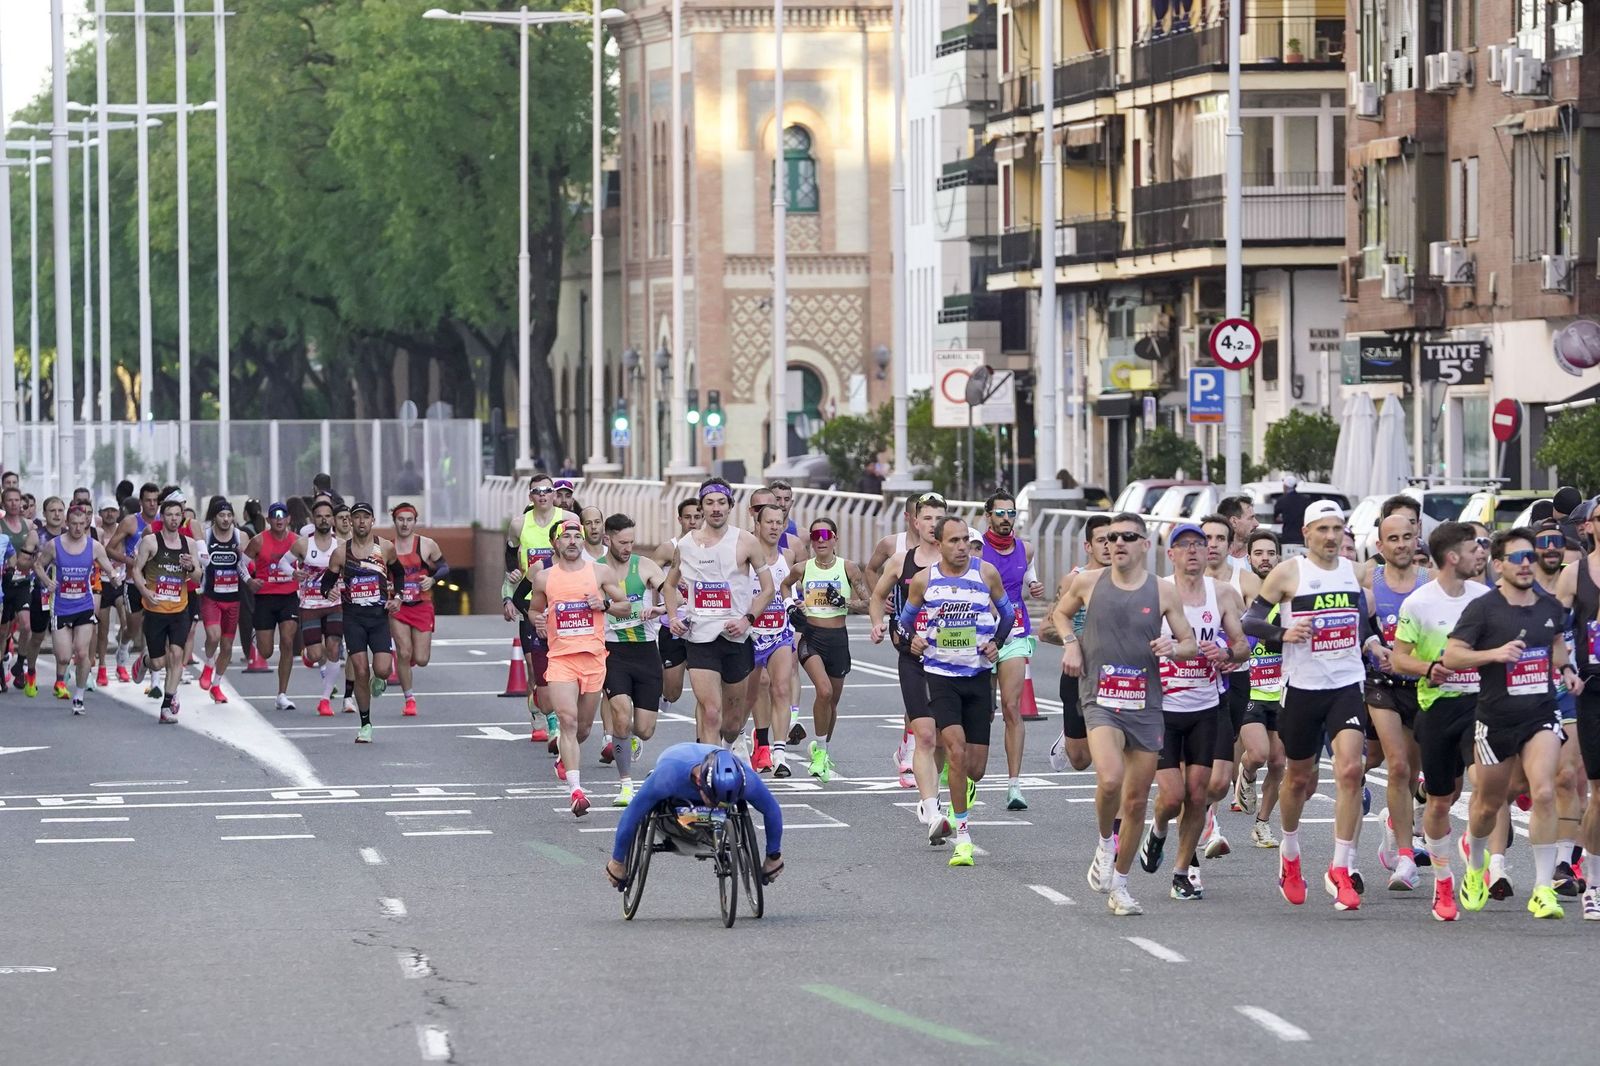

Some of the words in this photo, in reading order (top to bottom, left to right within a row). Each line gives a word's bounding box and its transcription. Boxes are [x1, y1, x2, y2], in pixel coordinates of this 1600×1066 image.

[1424, 344, 1480, 359] TINTE
[1194, 373, 1216, 402] P
[702, 599, 724, 608] ROBIN
[941, 602, 972, 613] CORRE
[1313, 593, 1350, 610] ASM
[559, 617, 590, 628] MICHAËL
[942, 639, 970, 647] CHERKI
[1314, 636, 1355, 651] MAYORGA
[1174, 667, 1207, 677] JEROME
[1511, 671, 1549, 686] MATHIA
[1098, 687, 1146, 699] ALEJANDRO
